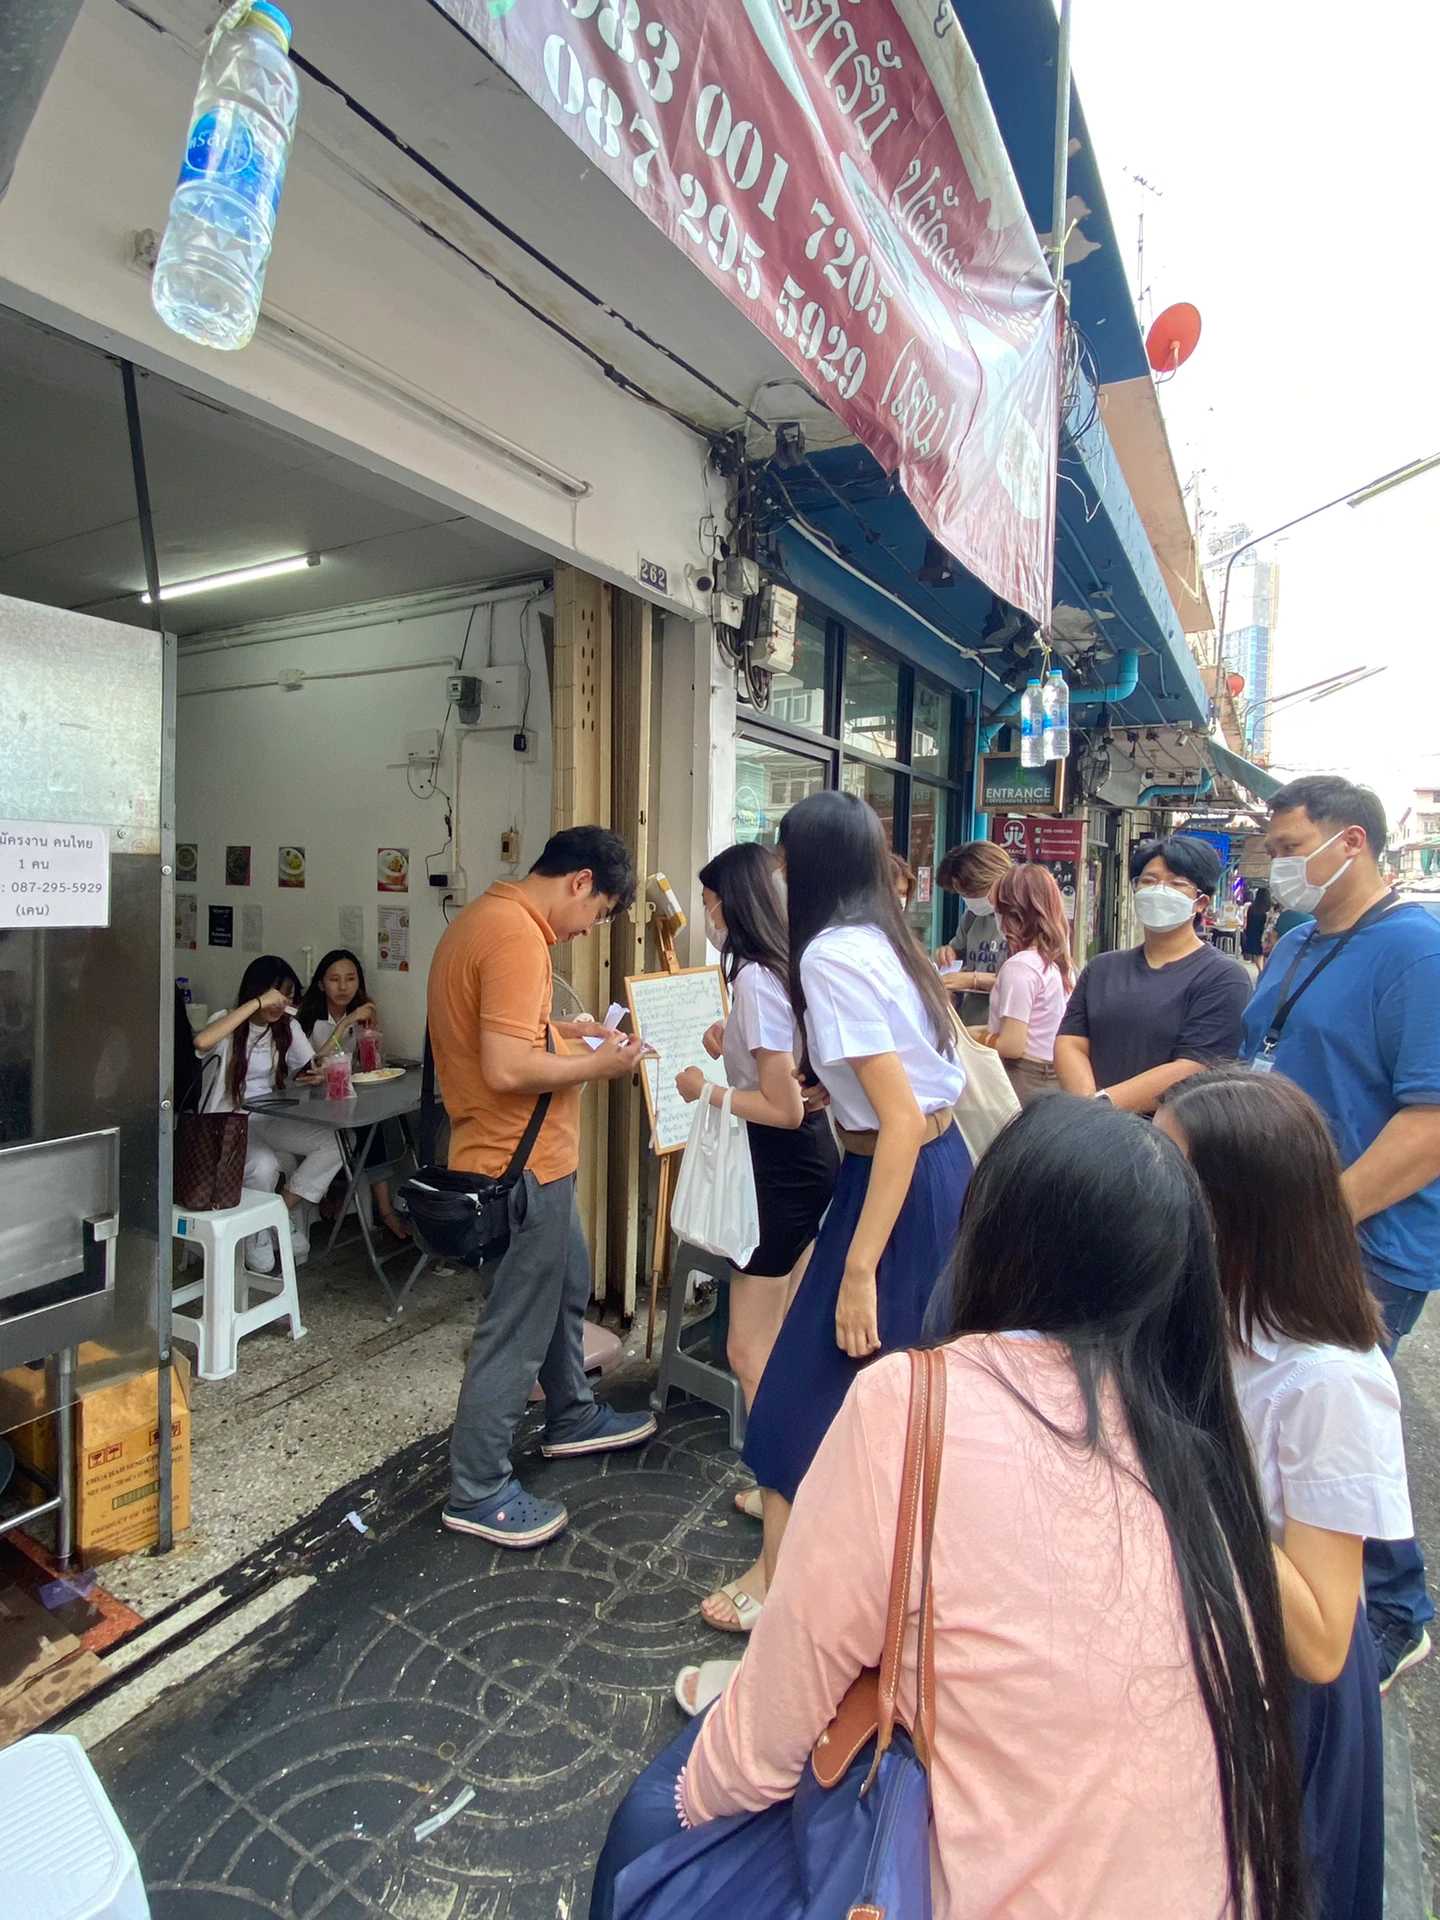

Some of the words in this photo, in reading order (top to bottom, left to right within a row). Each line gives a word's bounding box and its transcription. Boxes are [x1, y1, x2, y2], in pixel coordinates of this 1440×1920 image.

[561, 0, 680, 103] 83
[695, 84, 789, 221] 001
[805, 198, 893, 334] 7205
[543, 34, 660, 188] 087
[678, 173, 765, 300] 295
[775, 274, 866, 399] 5929
[641, 560, 666, 588] 262
[985, 786, 1051, 799] ENTRANCE
[53, 835, 93, 849] คนไทย
[18, 858, 24, 870] 1
[31, 859, 50, 870] คน
[11, 881, 103, 894] 087-295-5929
